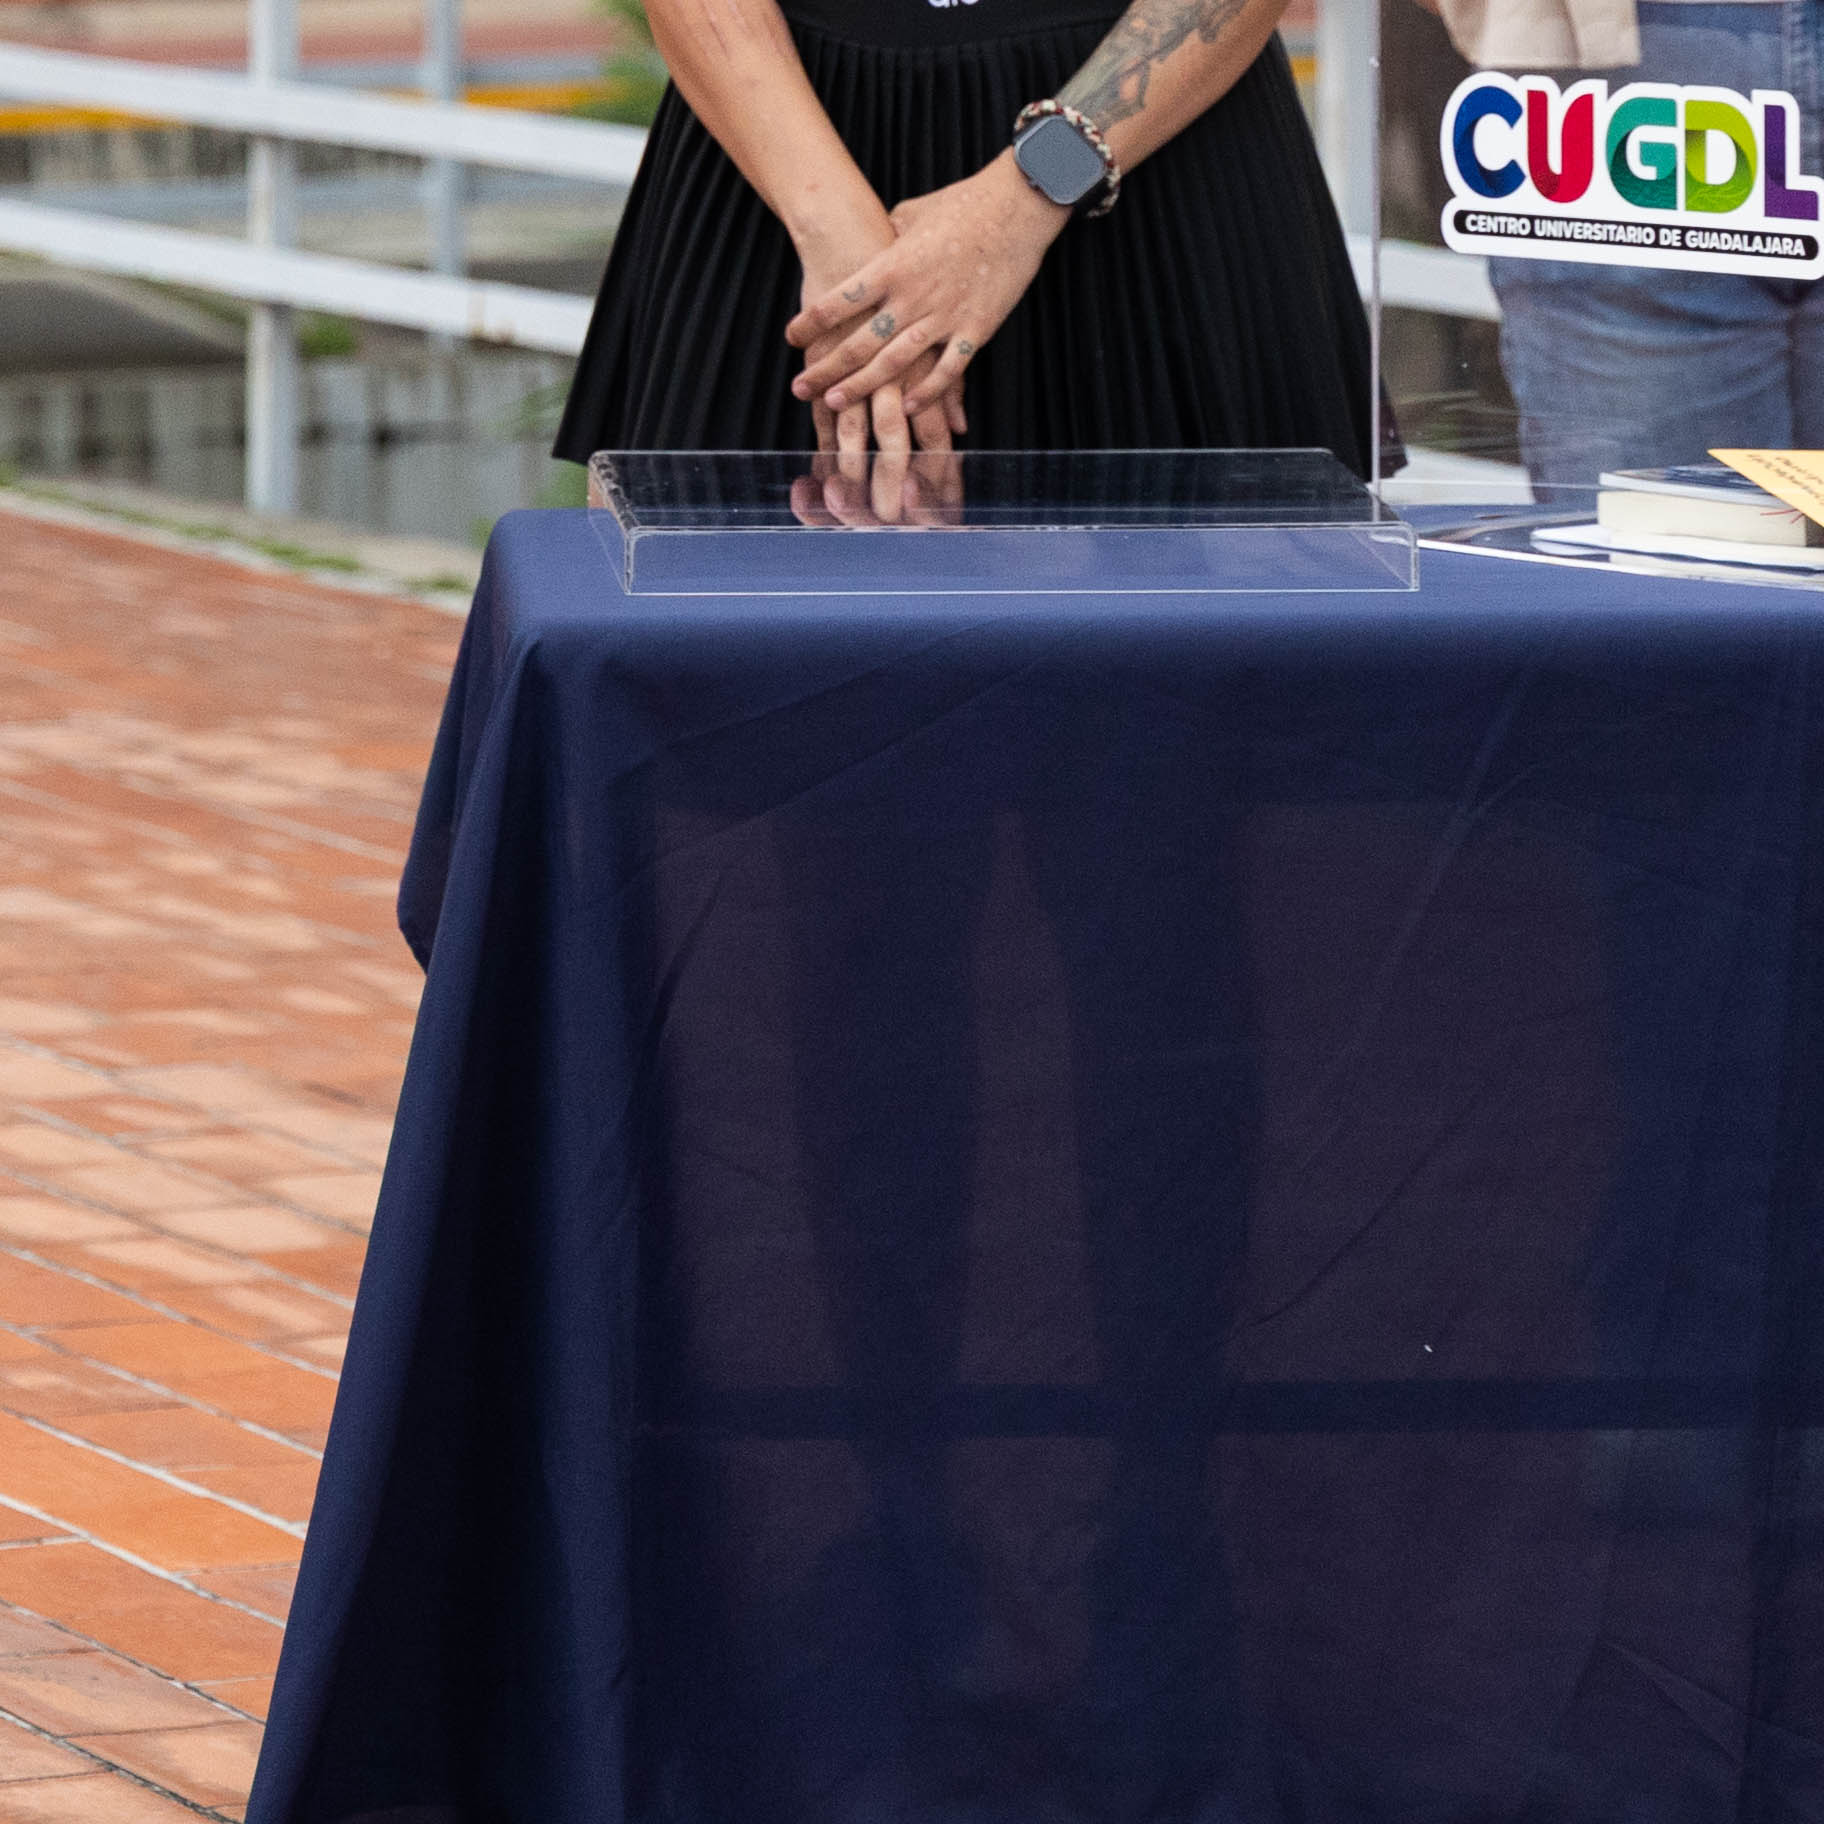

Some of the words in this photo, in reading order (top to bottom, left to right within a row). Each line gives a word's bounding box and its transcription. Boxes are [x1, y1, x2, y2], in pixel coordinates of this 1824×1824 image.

[1452, 85, 1820, 222] CUGDL
[1465, 213, 1532, 237] CENTRO
[1534, 218, 1654, 245] UNIVERSITARIO
[1659, 227, 1682, 247] DE
[1685, 229, 1806, 257] GUADALAJARA
